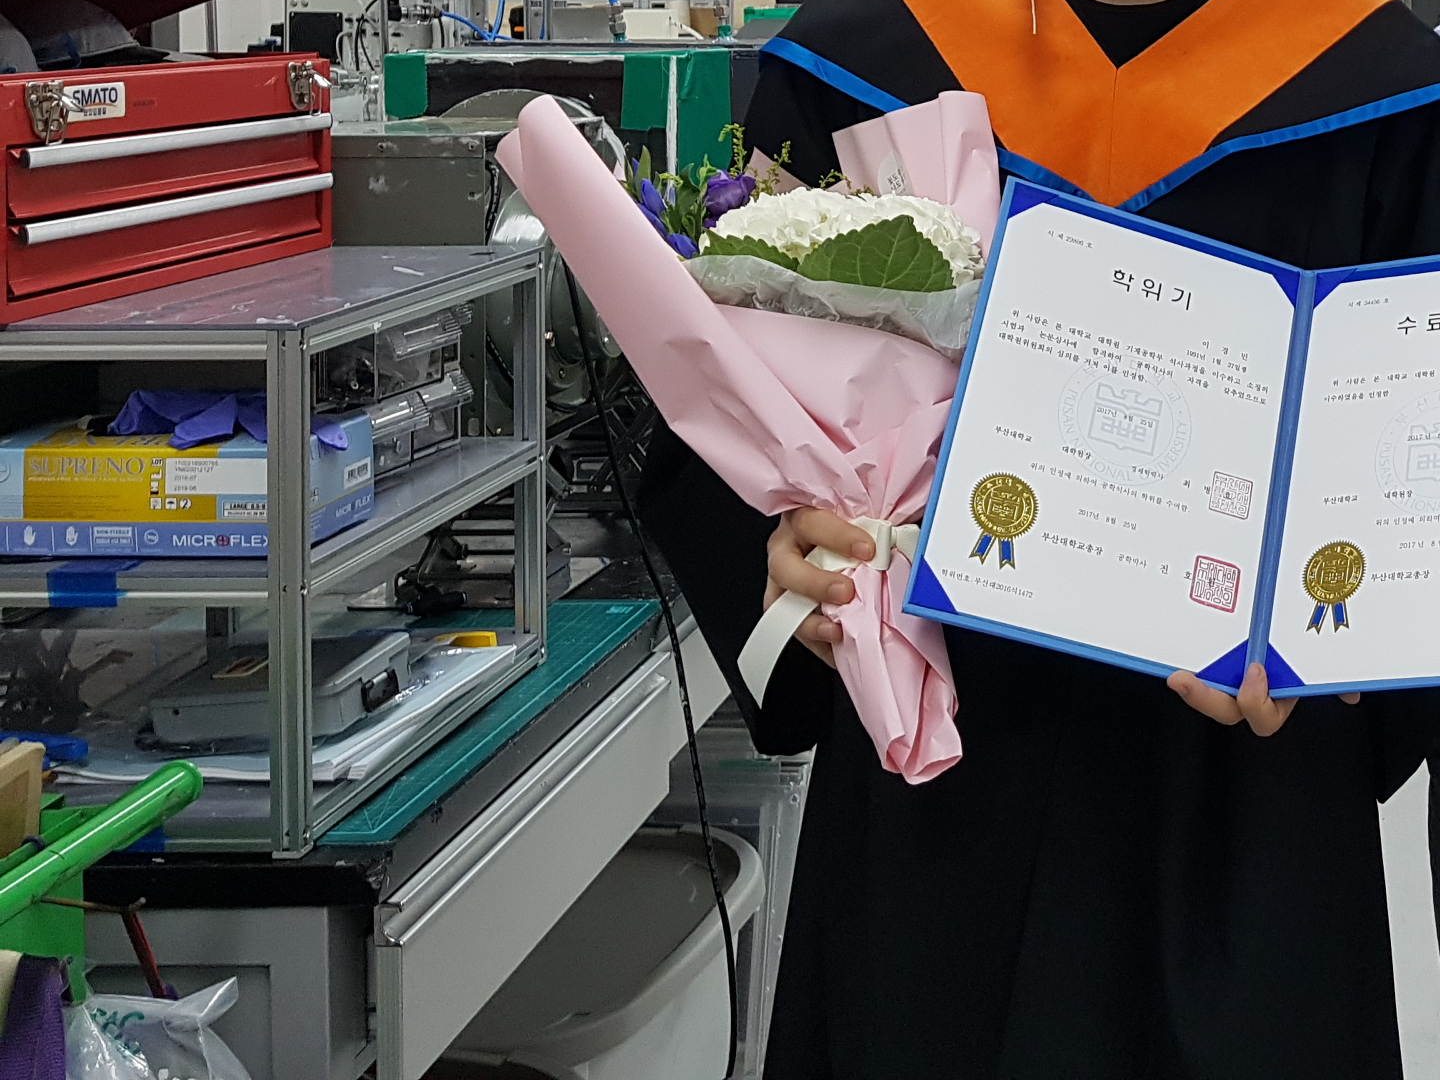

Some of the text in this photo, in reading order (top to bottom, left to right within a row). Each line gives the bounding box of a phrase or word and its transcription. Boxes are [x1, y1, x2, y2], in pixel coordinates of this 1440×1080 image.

[72, 87, 118, 106] SMATO
[1112, 269, 1192, 311] 학위기
[28, 457, 146, 475] SUPRENO
